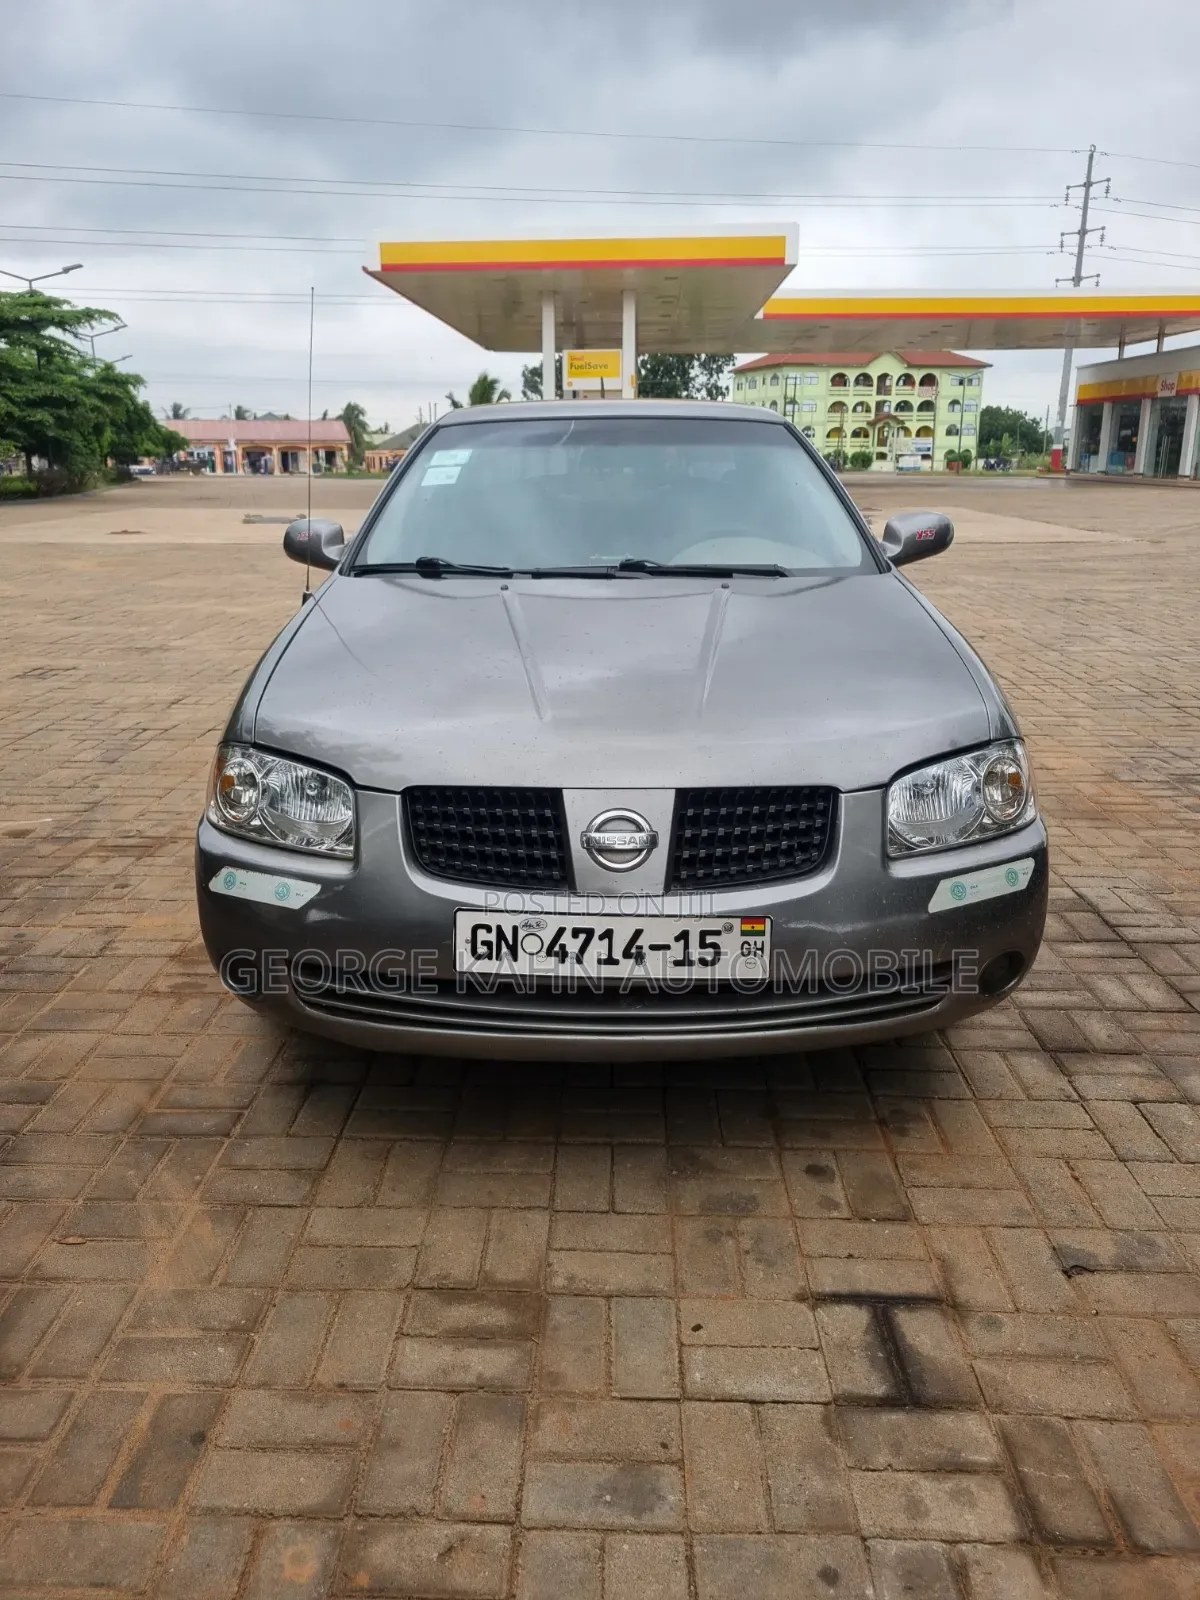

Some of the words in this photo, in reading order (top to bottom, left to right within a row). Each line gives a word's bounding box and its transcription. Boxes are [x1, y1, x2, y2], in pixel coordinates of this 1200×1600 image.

[570, 362, 609, 370] FuelSave
[1160, 378, 1175, 393] Shop
[589, 835, 650, 846] NISSAN
[470, 923, 519, 963] GN
[545, 926, 723, 968] 4714-15
[740, 940, 765, 958] GH
